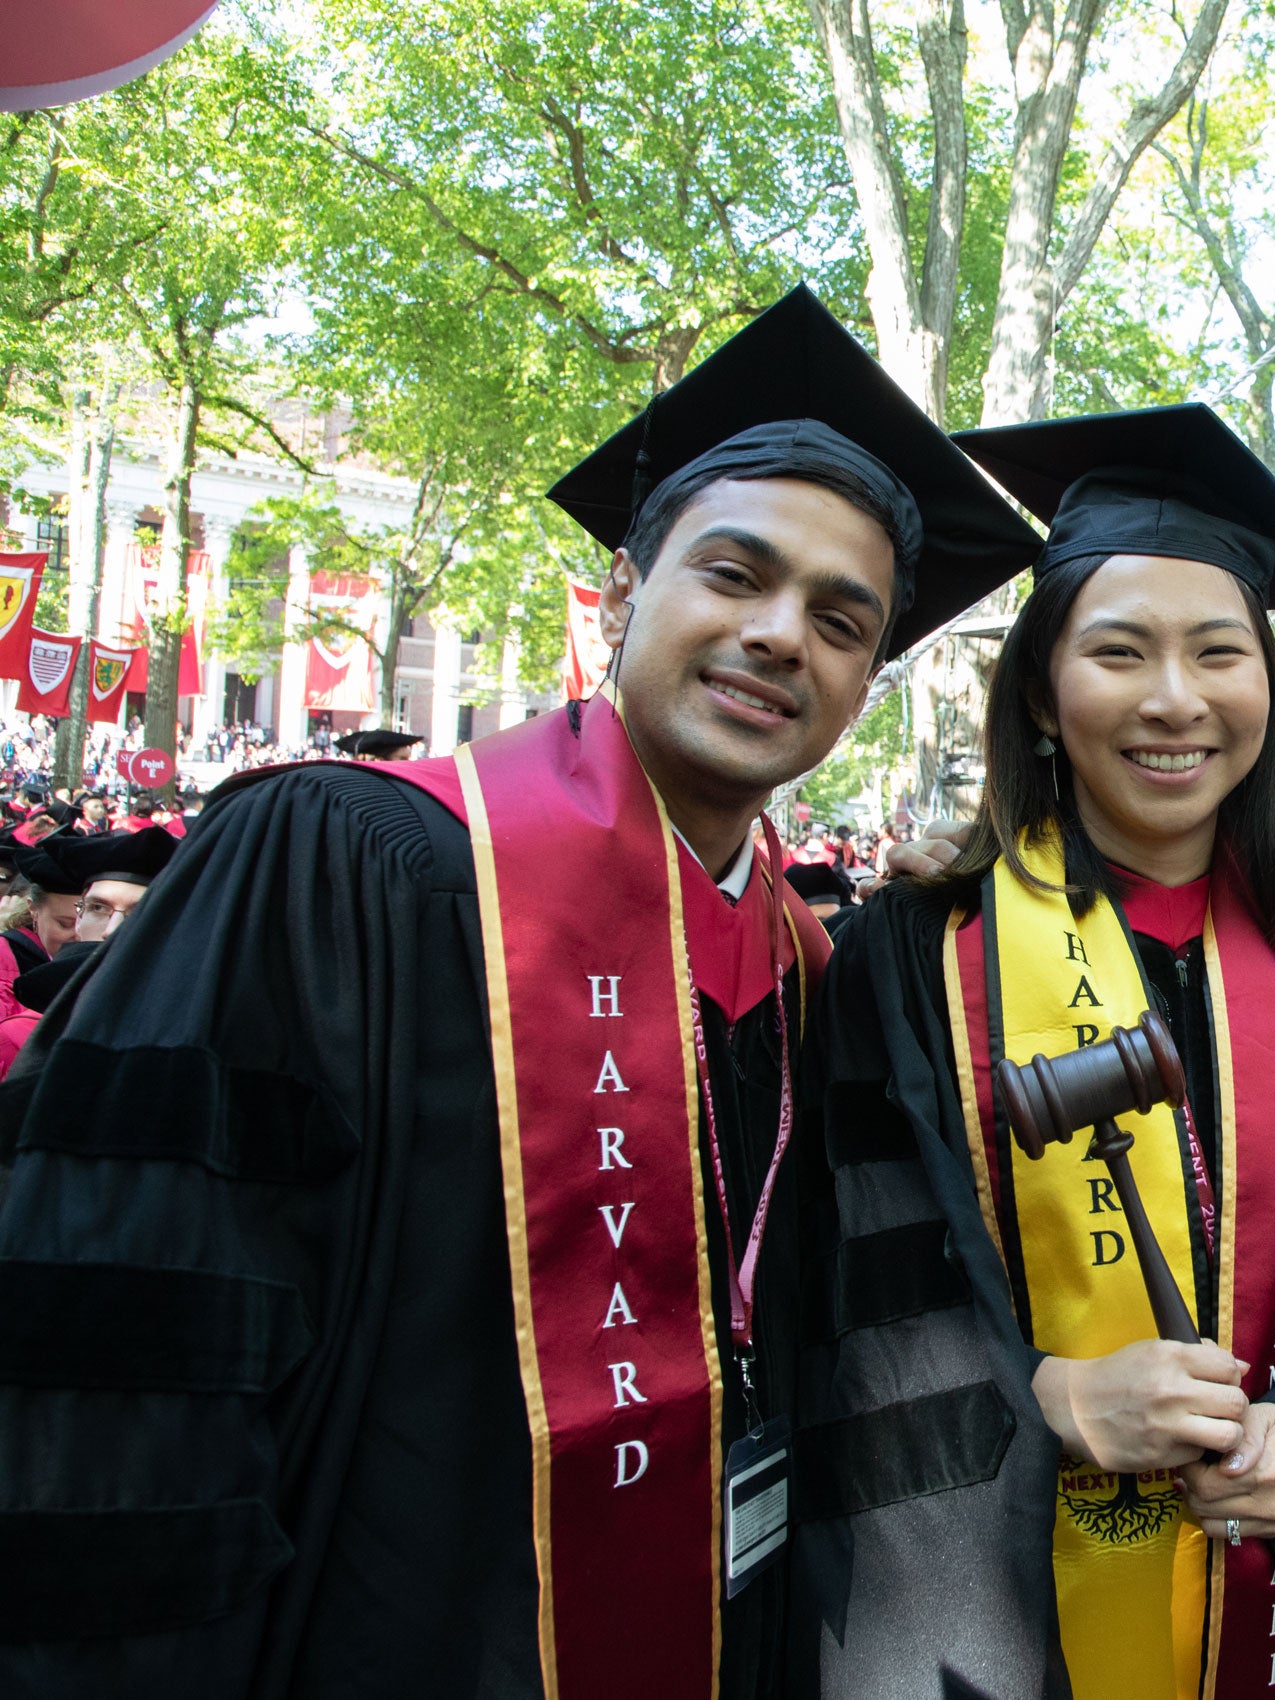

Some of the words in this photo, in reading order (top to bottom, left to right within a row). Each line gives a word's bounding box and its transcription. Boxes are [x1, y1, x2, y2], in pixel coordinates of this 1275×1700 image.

[141, 759, 165, 769] Point
[1063, 930, 1126, 1266] HARRD
[587, 975, 649, 1489] HARVARD
[1062, 1472, 1118, 1493] NEXT
